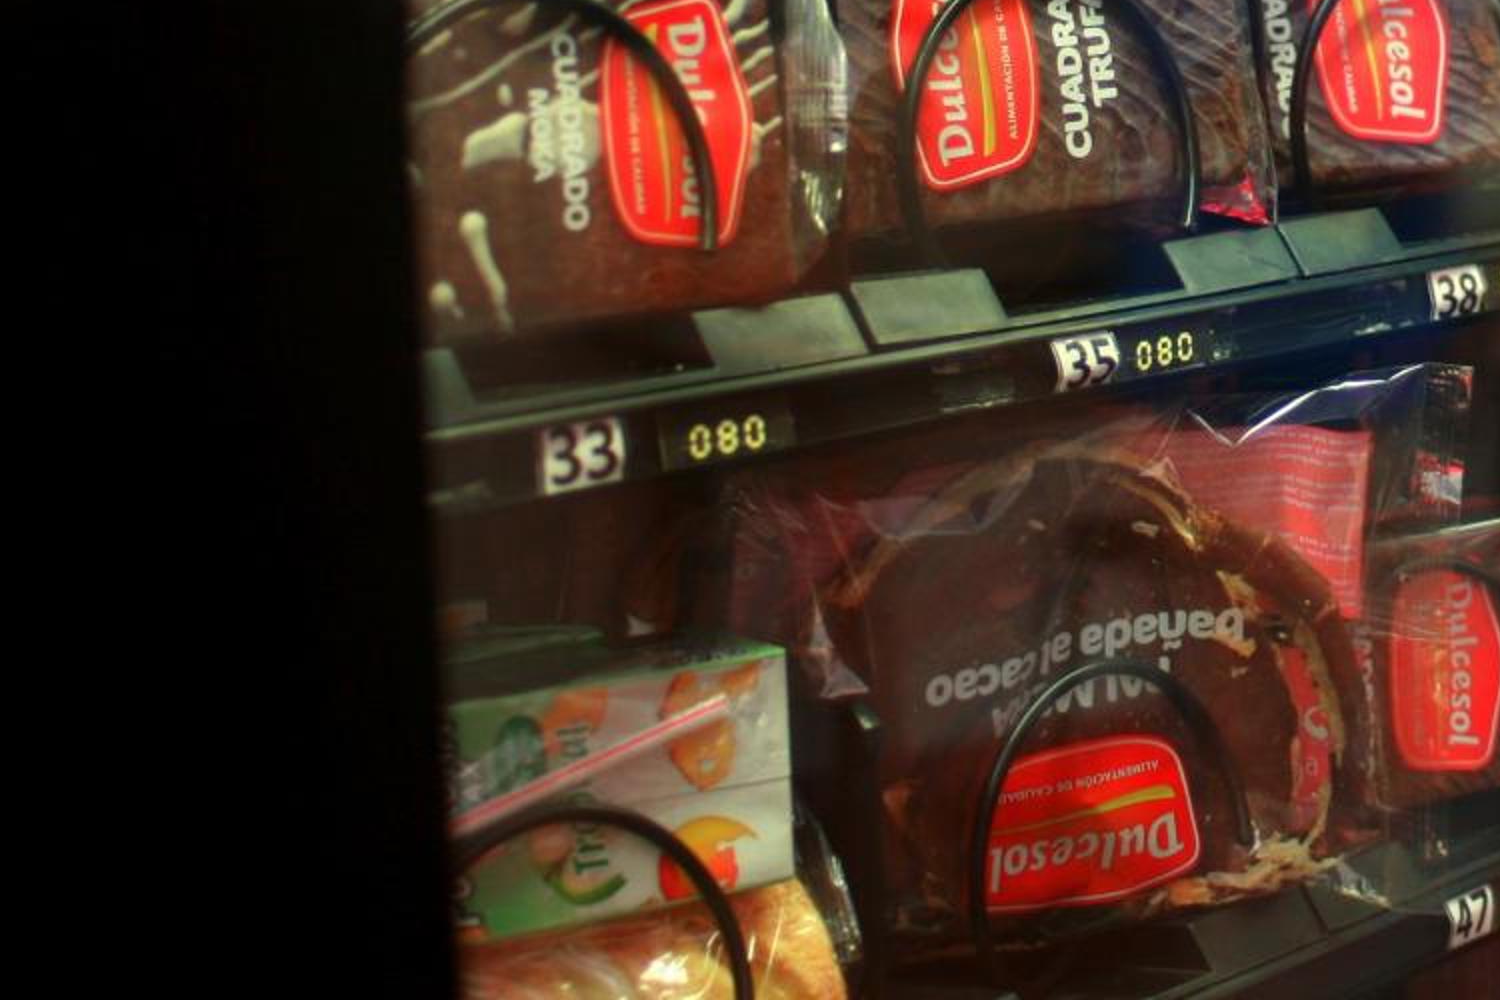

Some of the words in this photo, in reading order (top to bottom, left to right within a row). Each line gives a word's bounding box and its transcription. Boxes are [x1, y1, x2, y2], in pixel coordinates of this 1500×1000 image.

[552, 33, 592, 232] CUADRADO
[1436, 271, 1479, 315] 38
[1057, 337, 1118, 387] 35
[1136, 332, 1193, 370] 080
[546, 422, 620, 488] 33
[688, 415, 766, 459] 080
[1079, 607, 1246, 660] bañada
[1447, 576, 1480, 746] Dulcesol
[988, 809, 1185, 893] Dulcesol
[1454, 896, 1491, 939] 47
